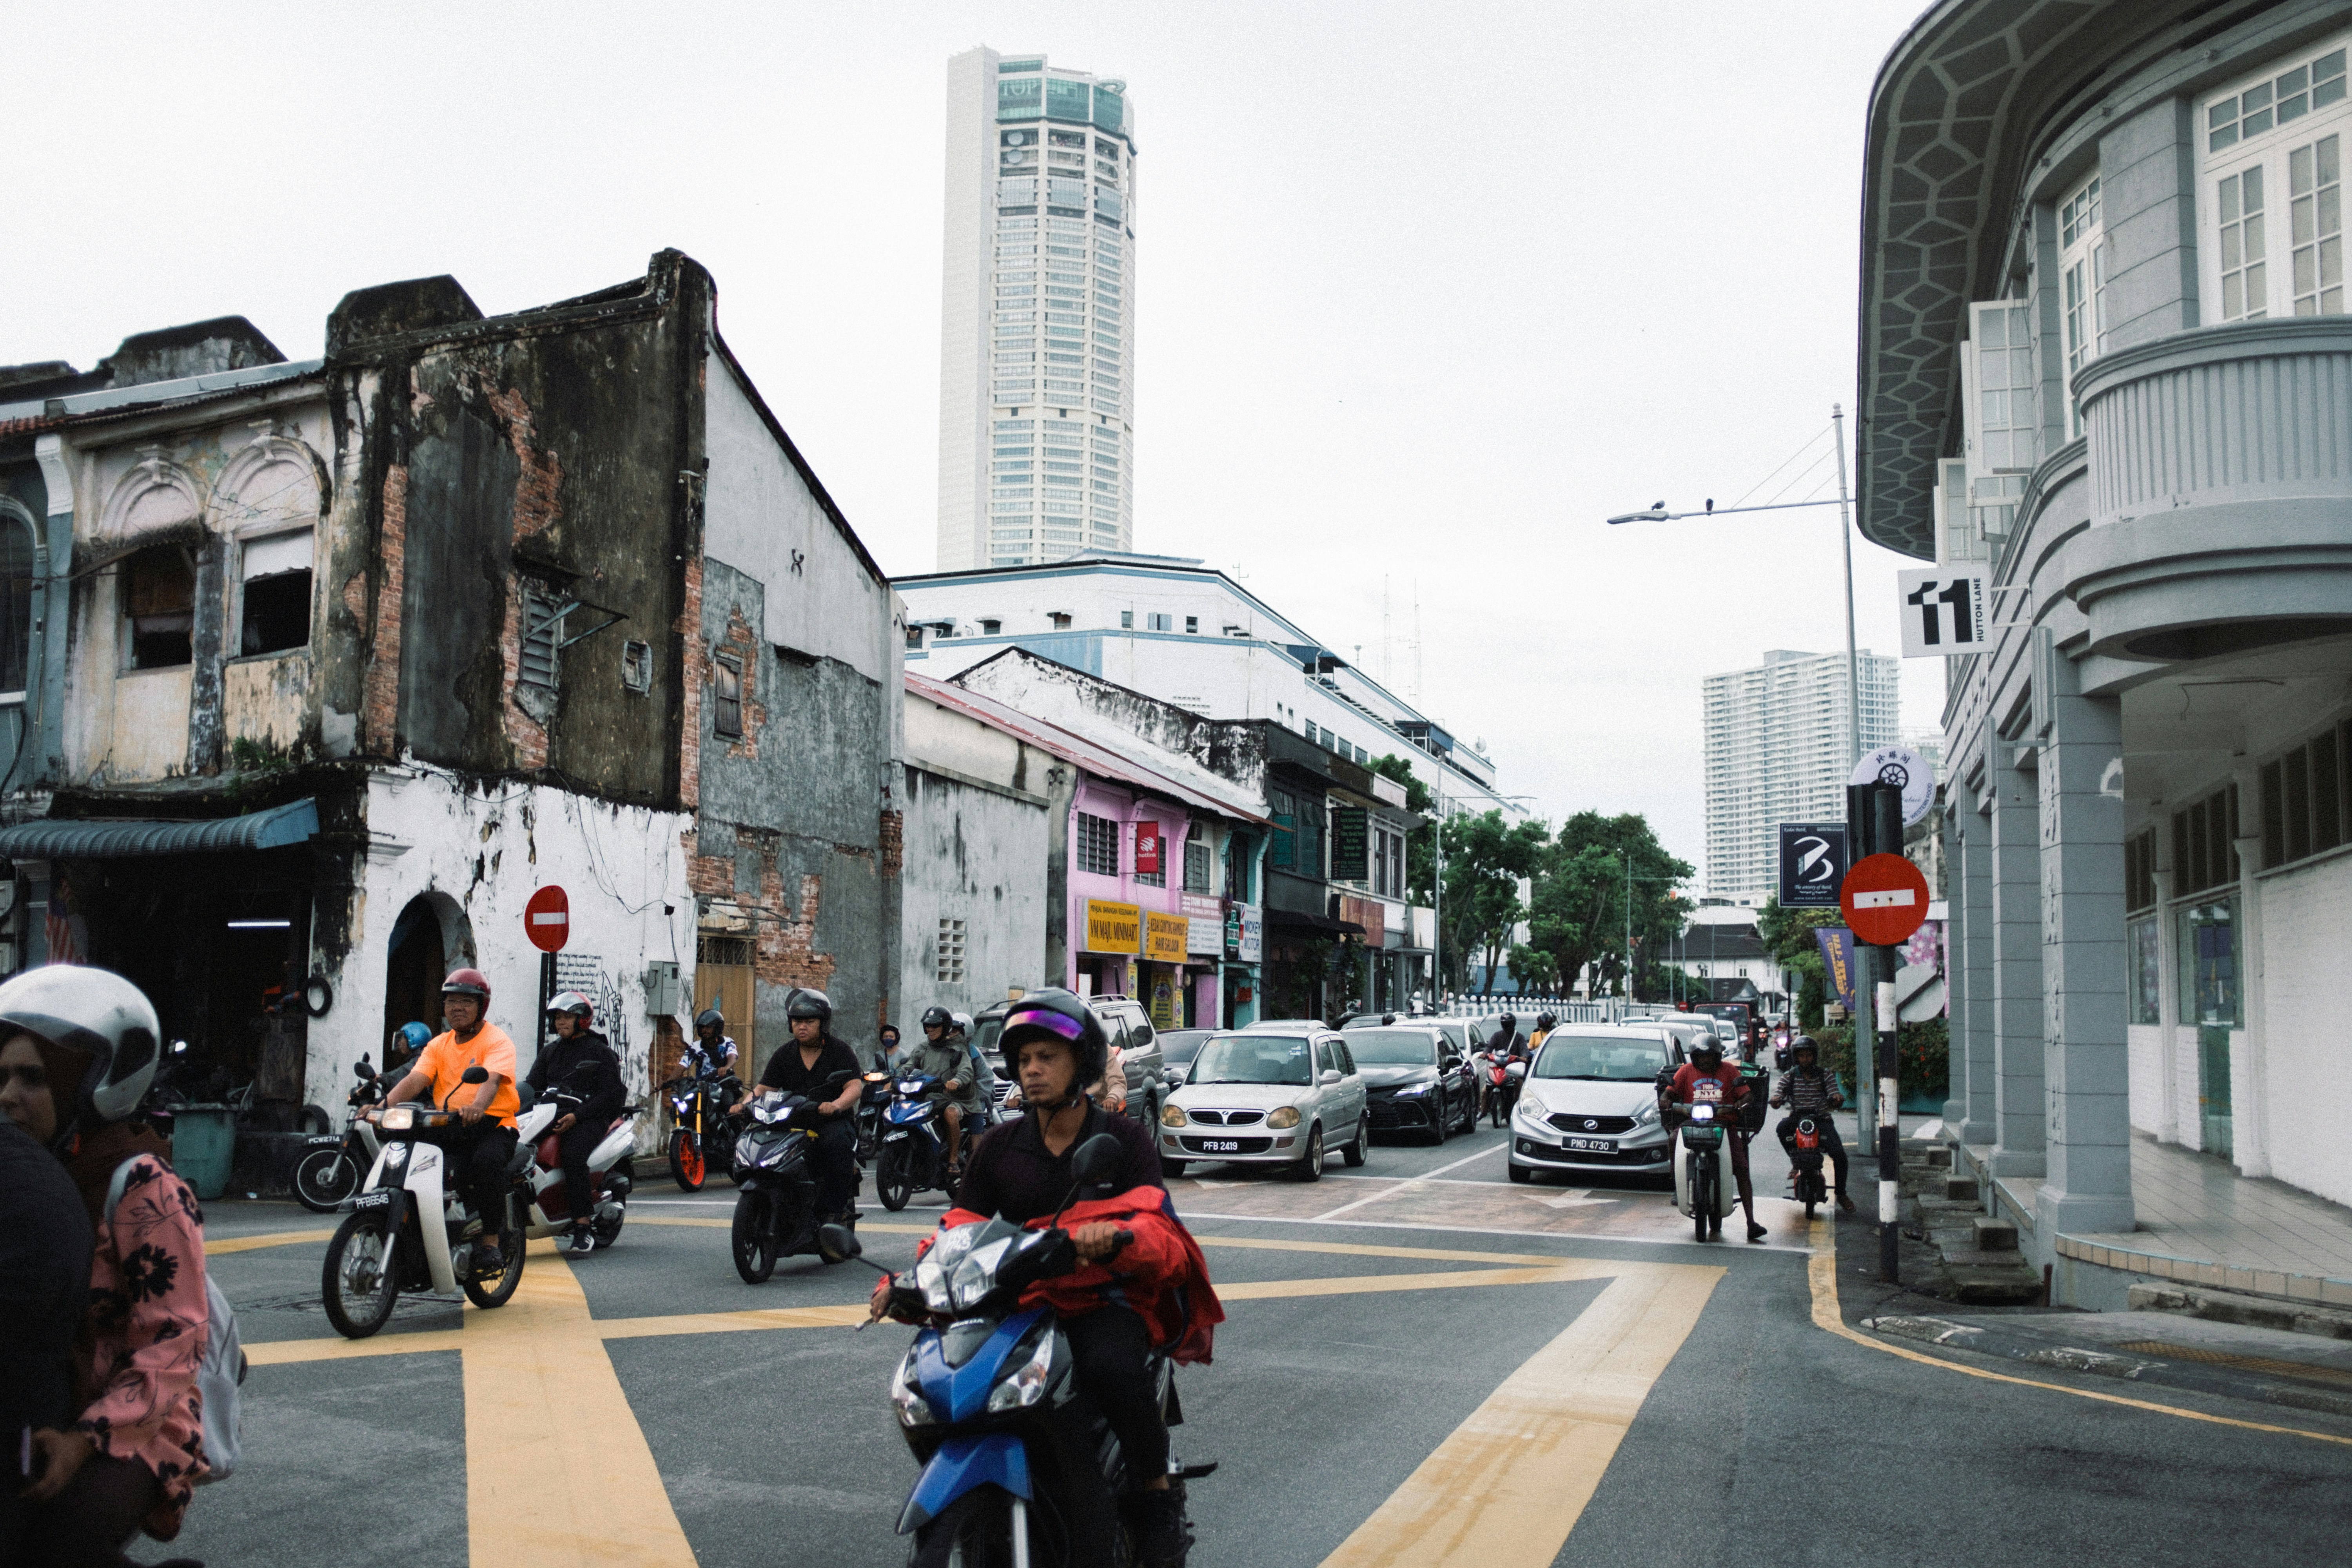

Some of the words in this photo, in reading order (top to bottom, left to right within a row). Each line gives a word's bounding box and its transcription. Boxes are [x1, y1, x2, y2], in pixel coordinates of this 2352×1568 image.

[1908, 579, 1973, 645] 11
[1975, 604, 1984, 642] HUTTON
[1910, 799, 1929, 819] WESTERN
[1244, 920, 1261, 935] MICKEY
[1156, 936, 1164, 951] HAIR
[1244, 937, 1260, 951] MOTOR
[1203, 1142, 1218, 1150] PFB
[1220, 1142, 1238, 1150] 2419
[1571, 1139, 1586, 1148] PMD
[1589, 1141, 1609, 1150] 4730
